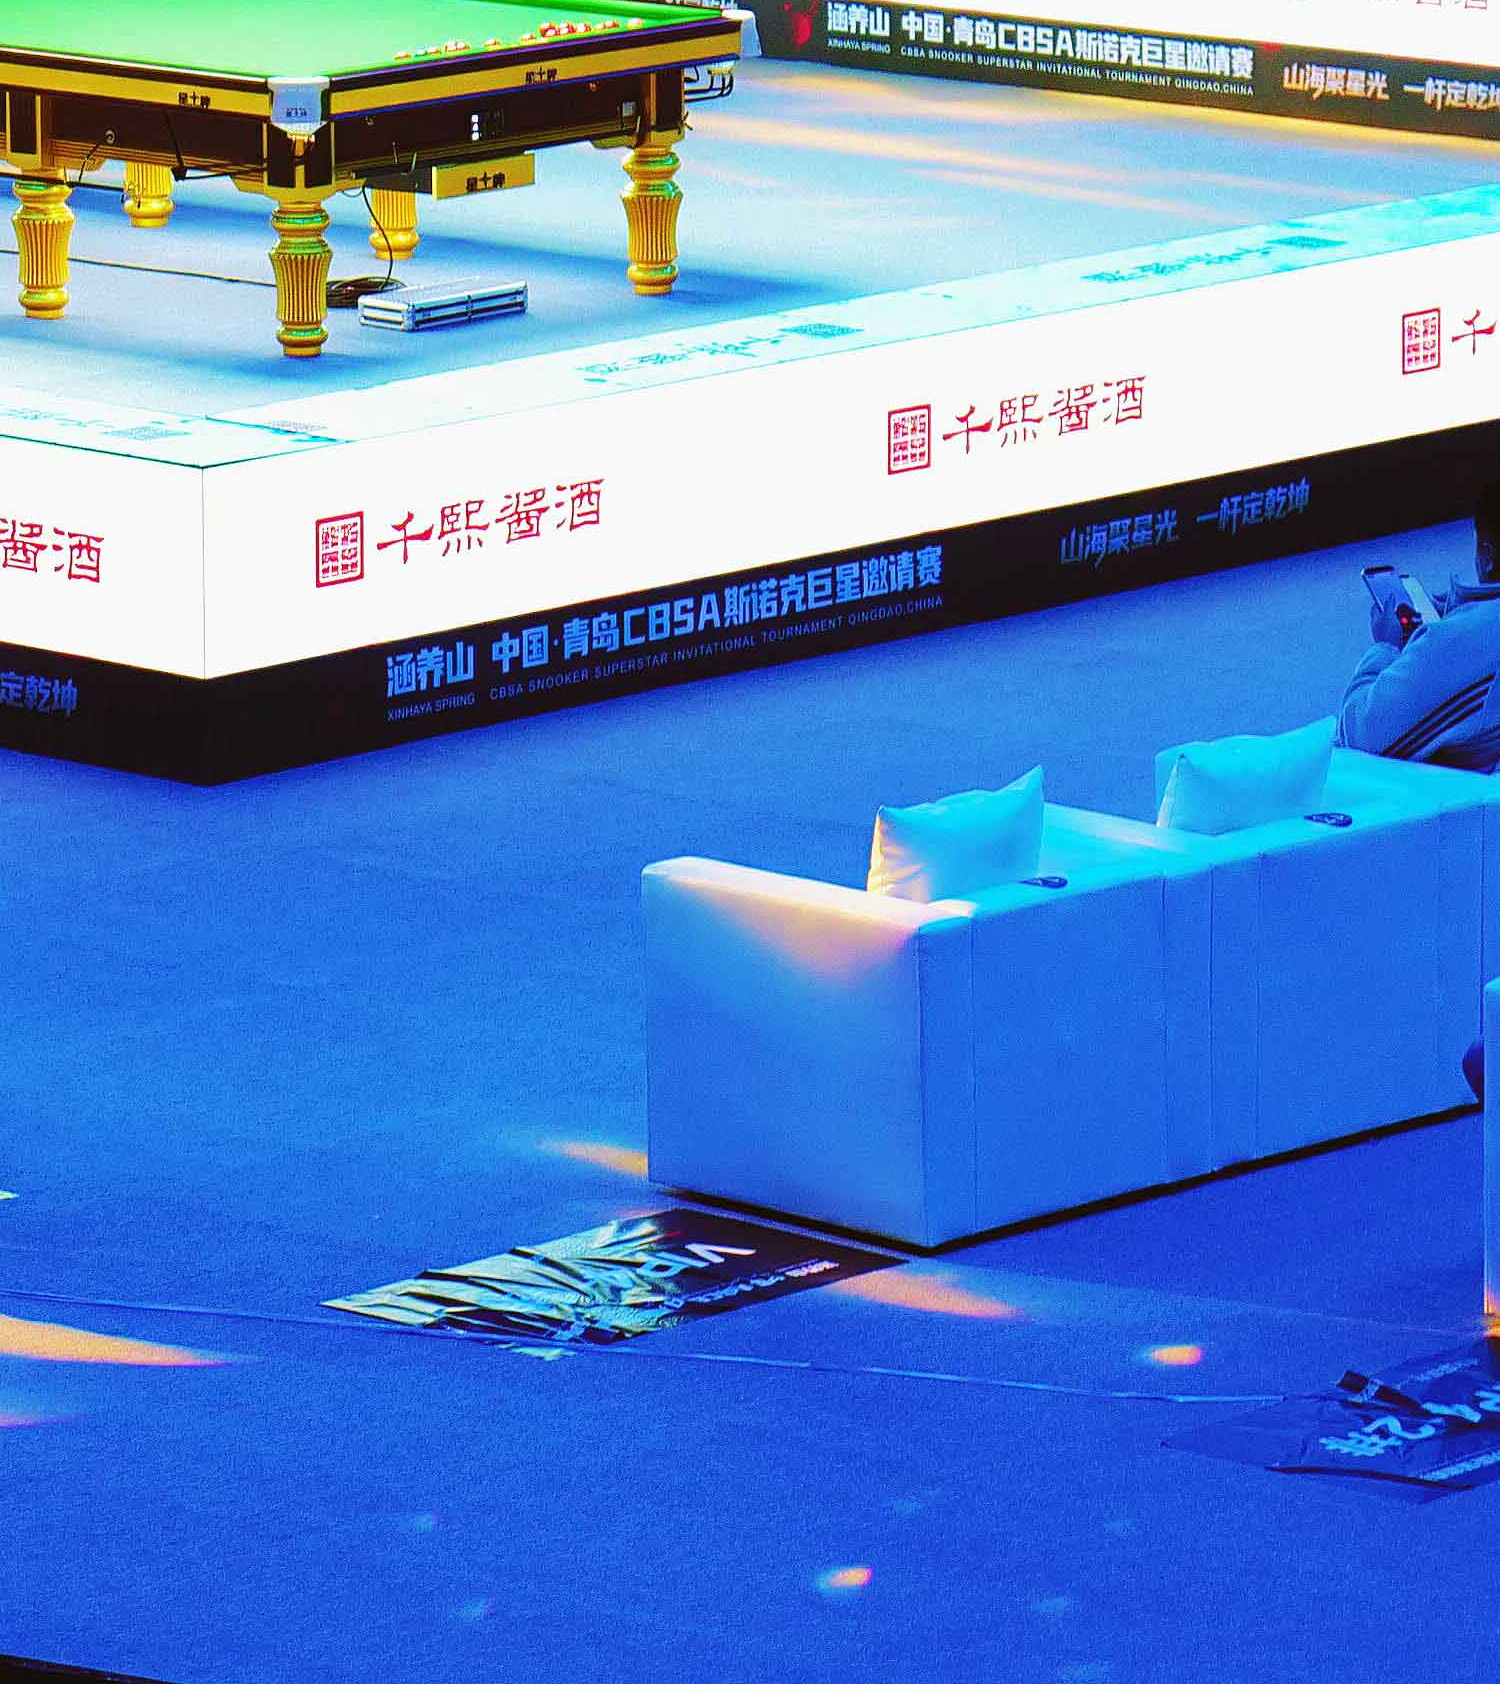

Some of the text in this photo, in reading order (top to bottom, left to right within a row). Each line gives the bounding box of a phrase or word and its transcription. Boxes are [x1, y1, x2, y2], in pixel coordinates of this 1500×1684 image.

[826, 1, 1255, 81] 涵养山 中国·青岛CBSA斯诺克巨星邀请赛
[901, 44, 927, 58] CBSA
[929, 47, 973, 64] SNOOKER
[975, 52, 1034, 71] SUPERSTAR
[1036, 59, 1102, 80] INVITATIONAL
[1104, 67, 1172, 89] TOURNAMENT
[1282, 61, 1391, 102] 山海聚星光
[943, 374, 1147, 456] 千熙酱酒
[376, 478, 606, 566] 千熙酱酒
[1059, 475, 1313, 569] 山海聚星光 一杆定乾坤
[385, 544, 943, 699] 涵养山 中国·青岛CBSA斯诺克巨星邀请赛
[434, 691, 476, 714] SPRING
[489, 681, 524, 702] CBSA
[528, 668, 590, 695] SNOOKER
[593, 651, 668, 682] SUPERSTAR
[672, 634, 757, 665] INVITATIONAL
[761, 616, 844, 646] TOURNAMENT
